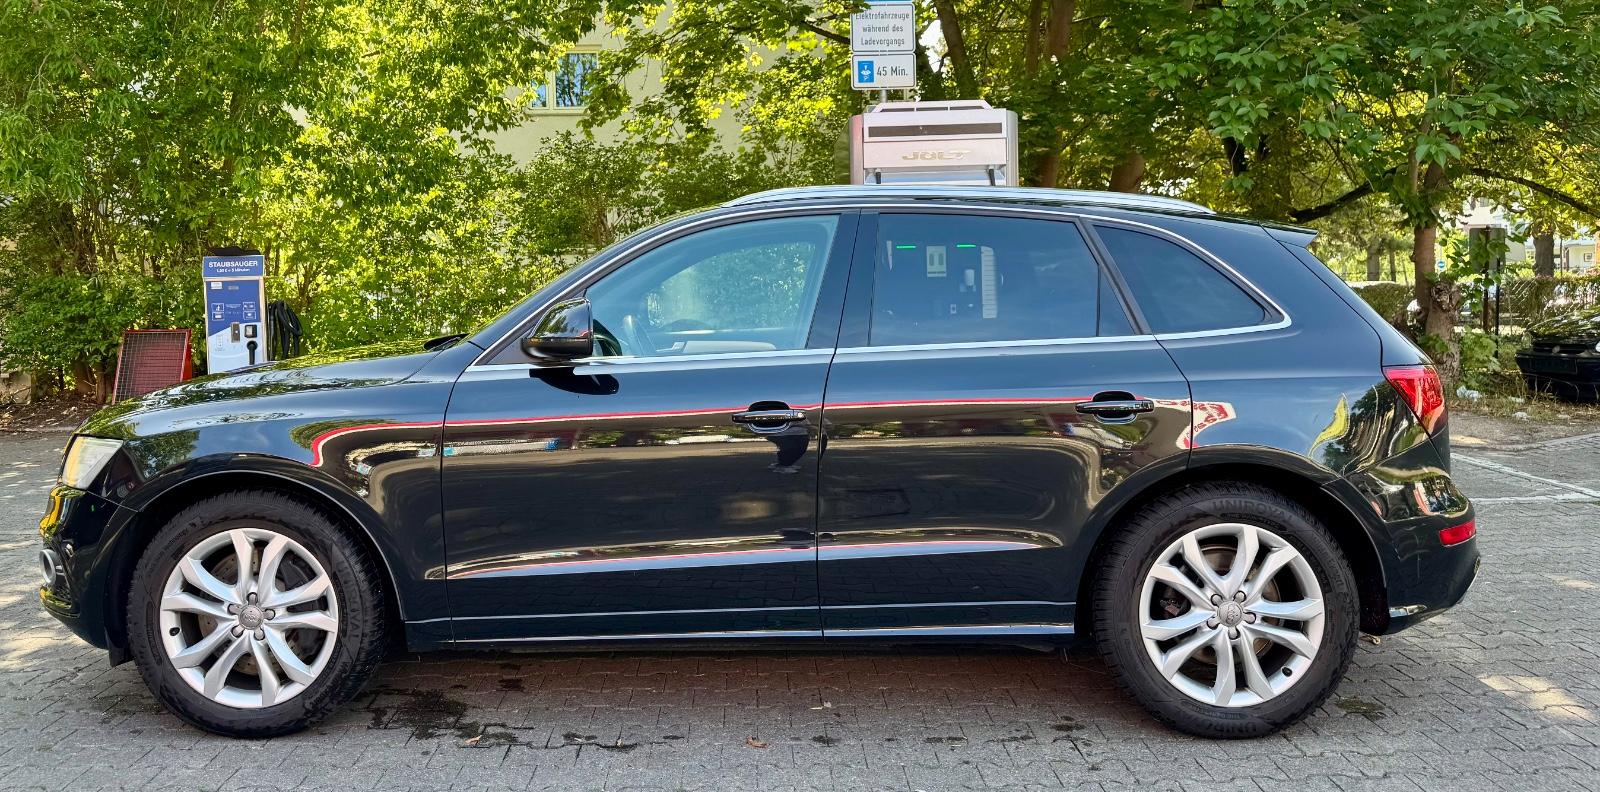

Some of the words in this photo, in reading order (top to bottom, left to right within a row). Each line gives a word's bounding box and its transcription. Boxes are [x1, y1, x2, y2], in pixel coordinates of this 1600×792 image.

[862, 24, 890, 32] während
[892, 24, 904, 32] des
[861, 37, 905, 46] Ladevorgangs
[876, 66, 888, 76] 45
[890, 66, 909, 76] Min.
[208, 260, 258, 268] STAUBSAUGER
